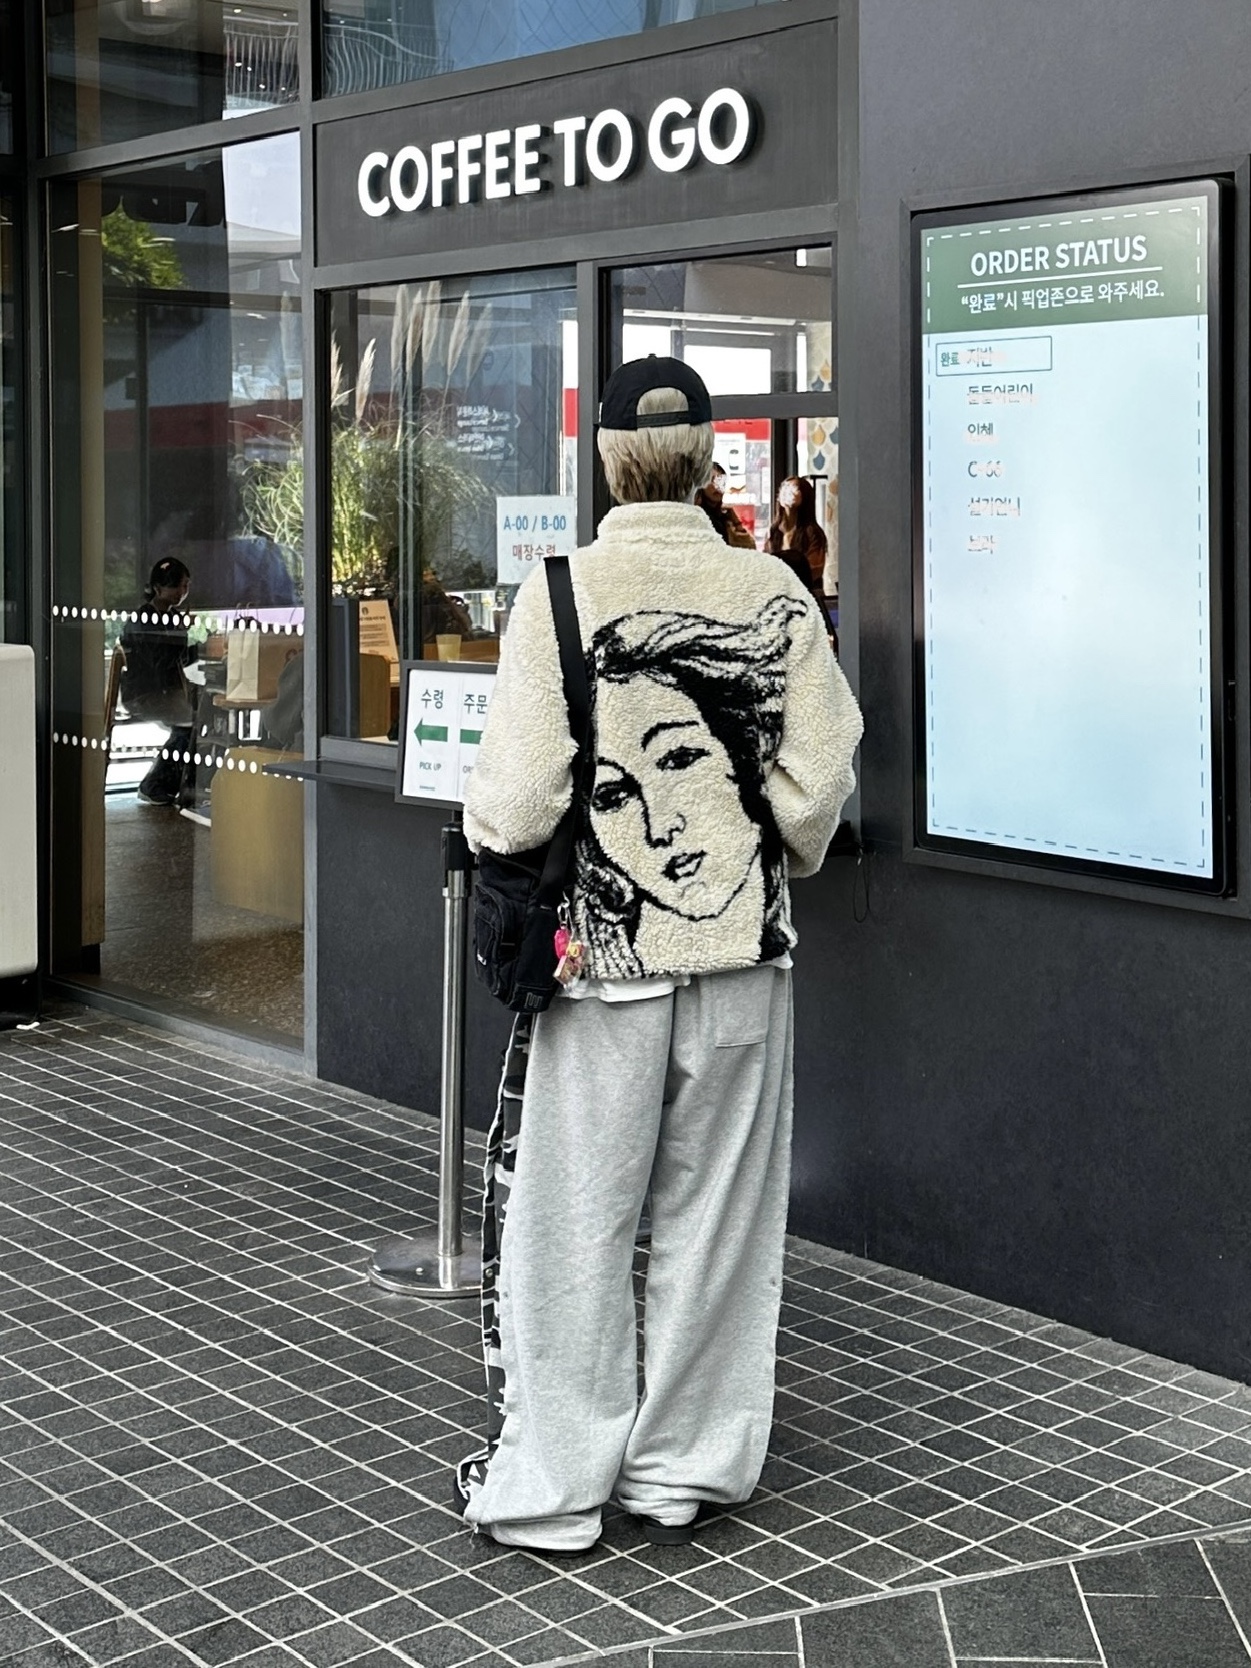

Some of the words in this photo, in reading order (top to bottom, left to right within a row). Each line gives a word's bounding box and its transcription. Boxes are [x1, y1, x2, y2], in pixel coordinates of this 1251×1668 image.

[358, 124, 541, 217] COFFEE
[553, 108, 634, 187] TO
[648, 87, 751, 173] GO
[970, 246, 1050, 276] ORDER
[1055, 234, 1148, 268] STATUS
[1021, 284, 1095, 310] 픽업존으로
[1097, 279, 1165, 302] 와주세요.
[940, 351, 960, 367] 완료
[503, 515, 529, 531] A-00
[532, 515, 538, 533] /
[541, 515, 567, 531] B-00
[421, 688, 444, 710] 수령
[463, 693, 488, 715] 주문
[419, 761, 432, 771] PICK
[433, 762, 442, 772] UP
